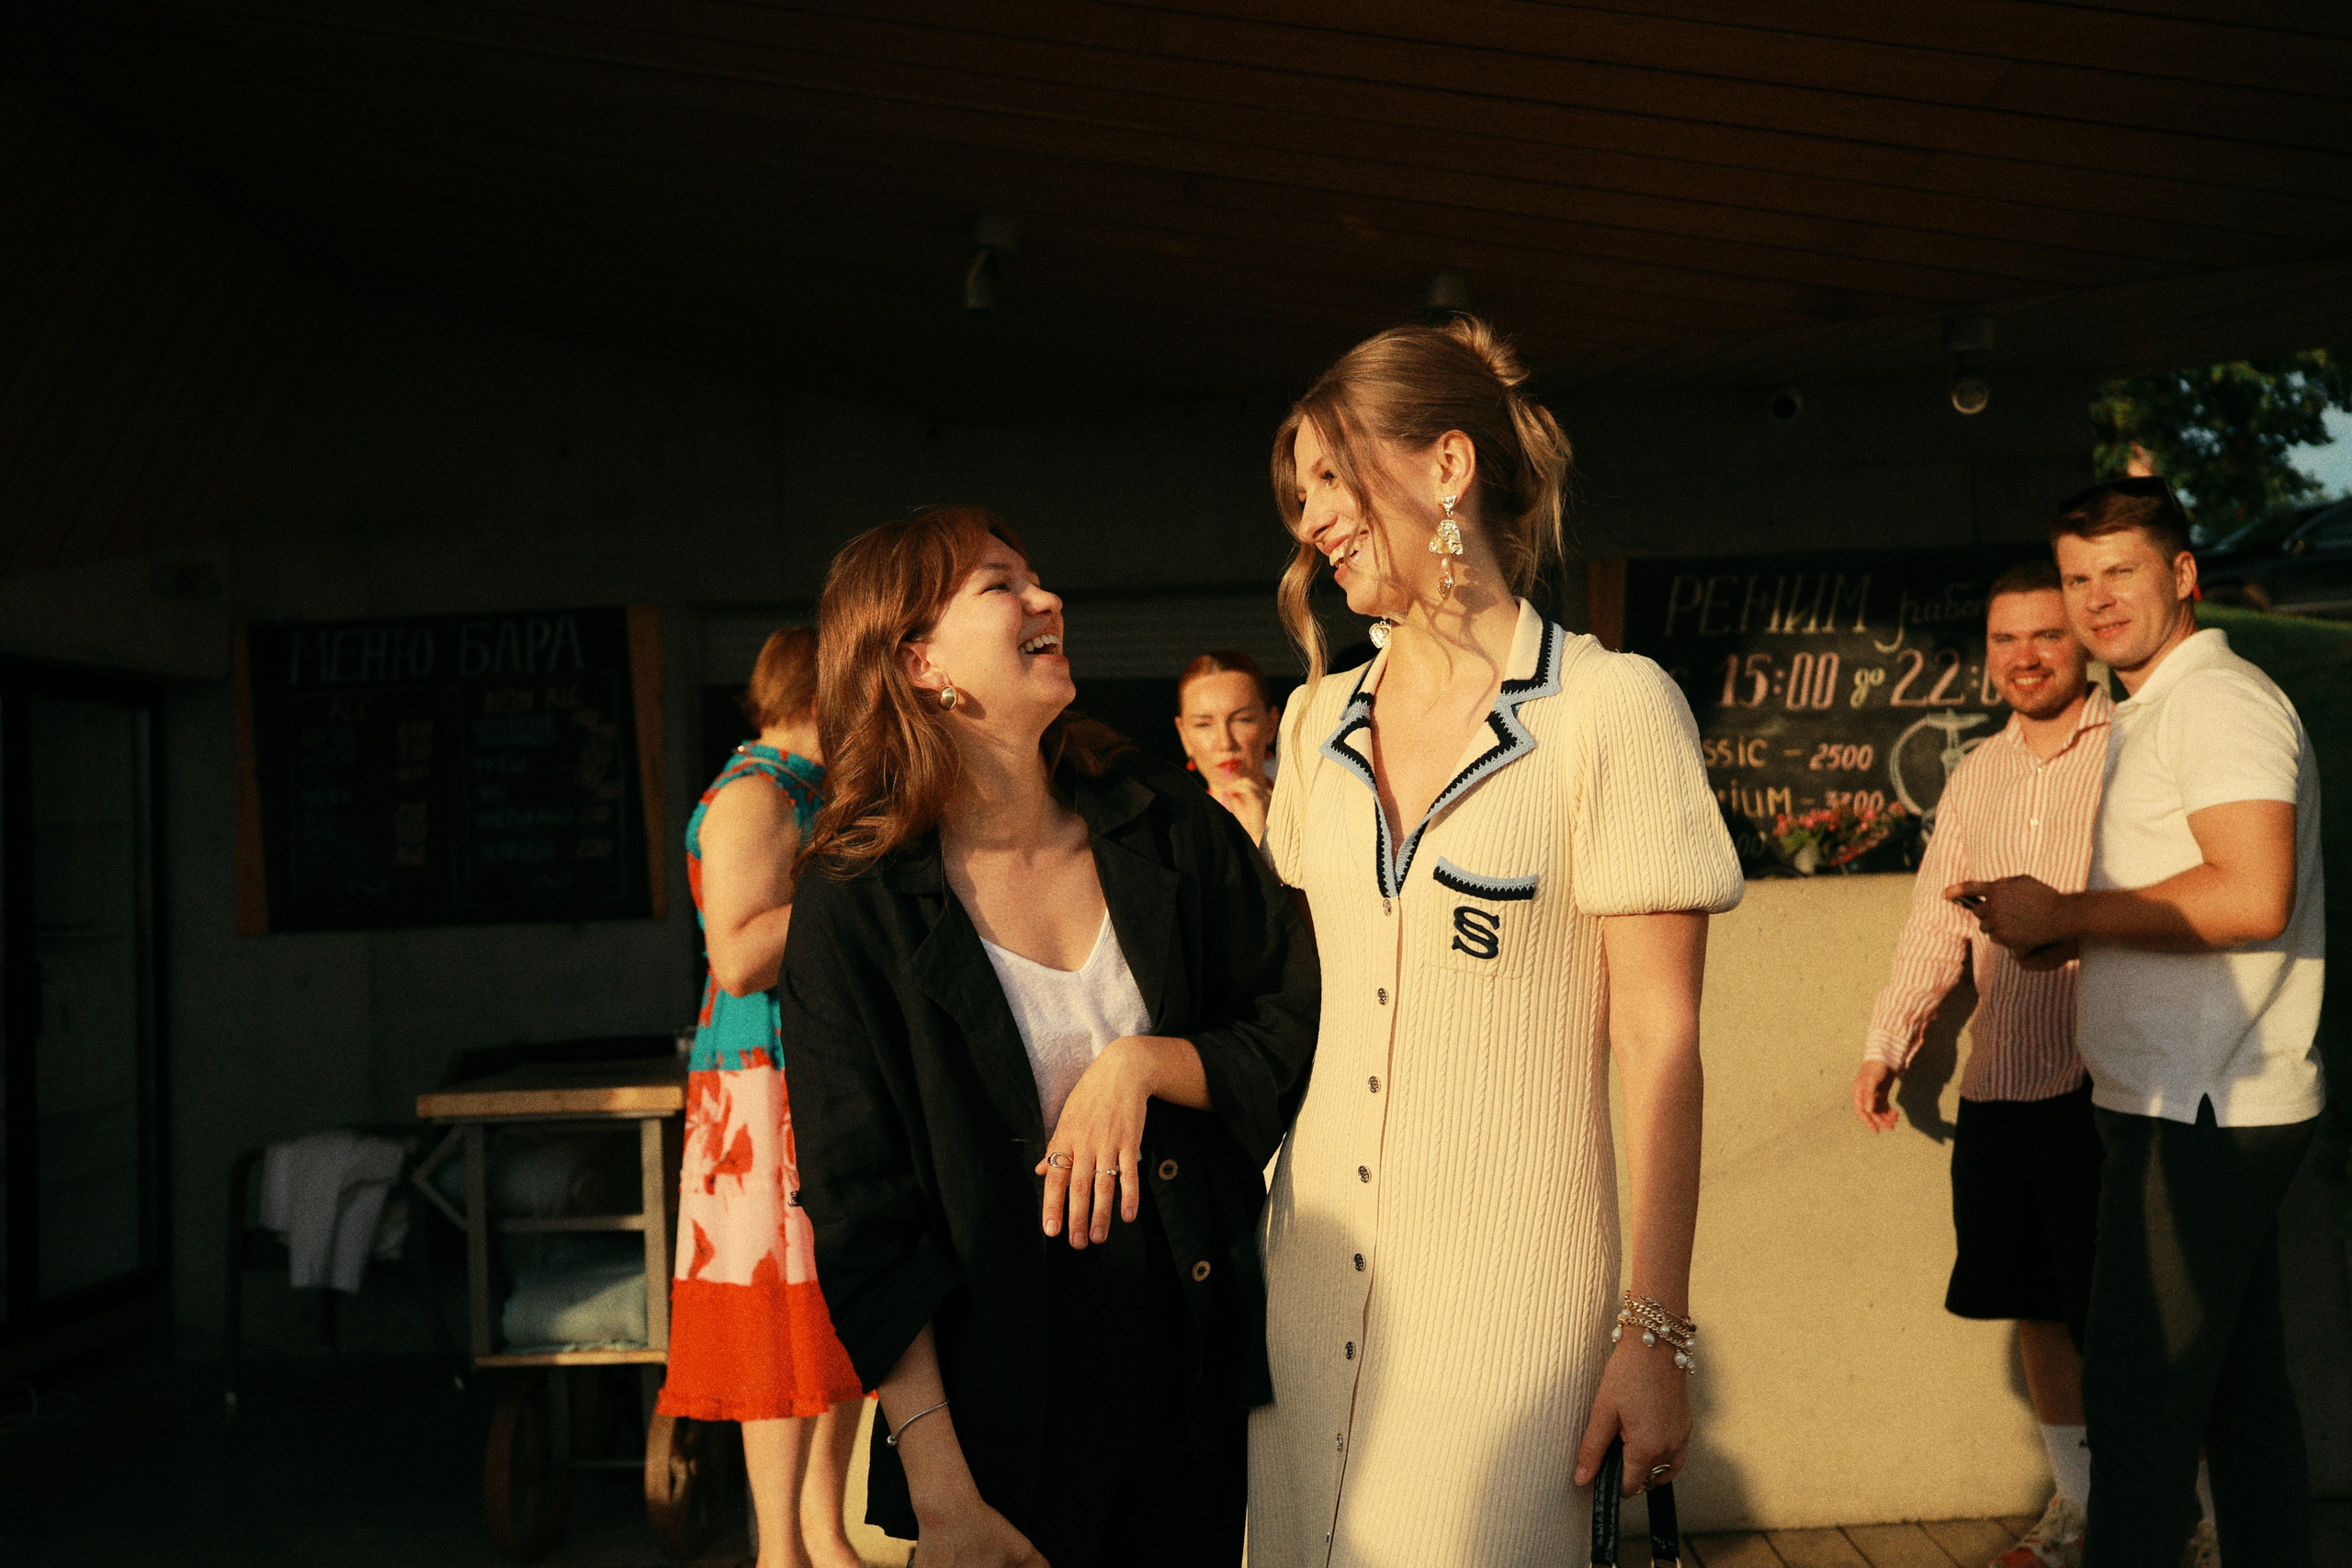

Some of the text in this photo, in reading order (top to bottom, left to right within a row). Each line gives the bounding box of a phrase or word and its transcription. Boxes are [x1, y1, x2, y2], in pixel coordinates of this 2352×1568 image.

[288, 614, 585, 686] МЕНЮ БАРА
[1714, 651, 1839, 710] 15:00
[1889, 648, 2005, 707] 22:0
[1809, 742, 1875, 772] 2500
